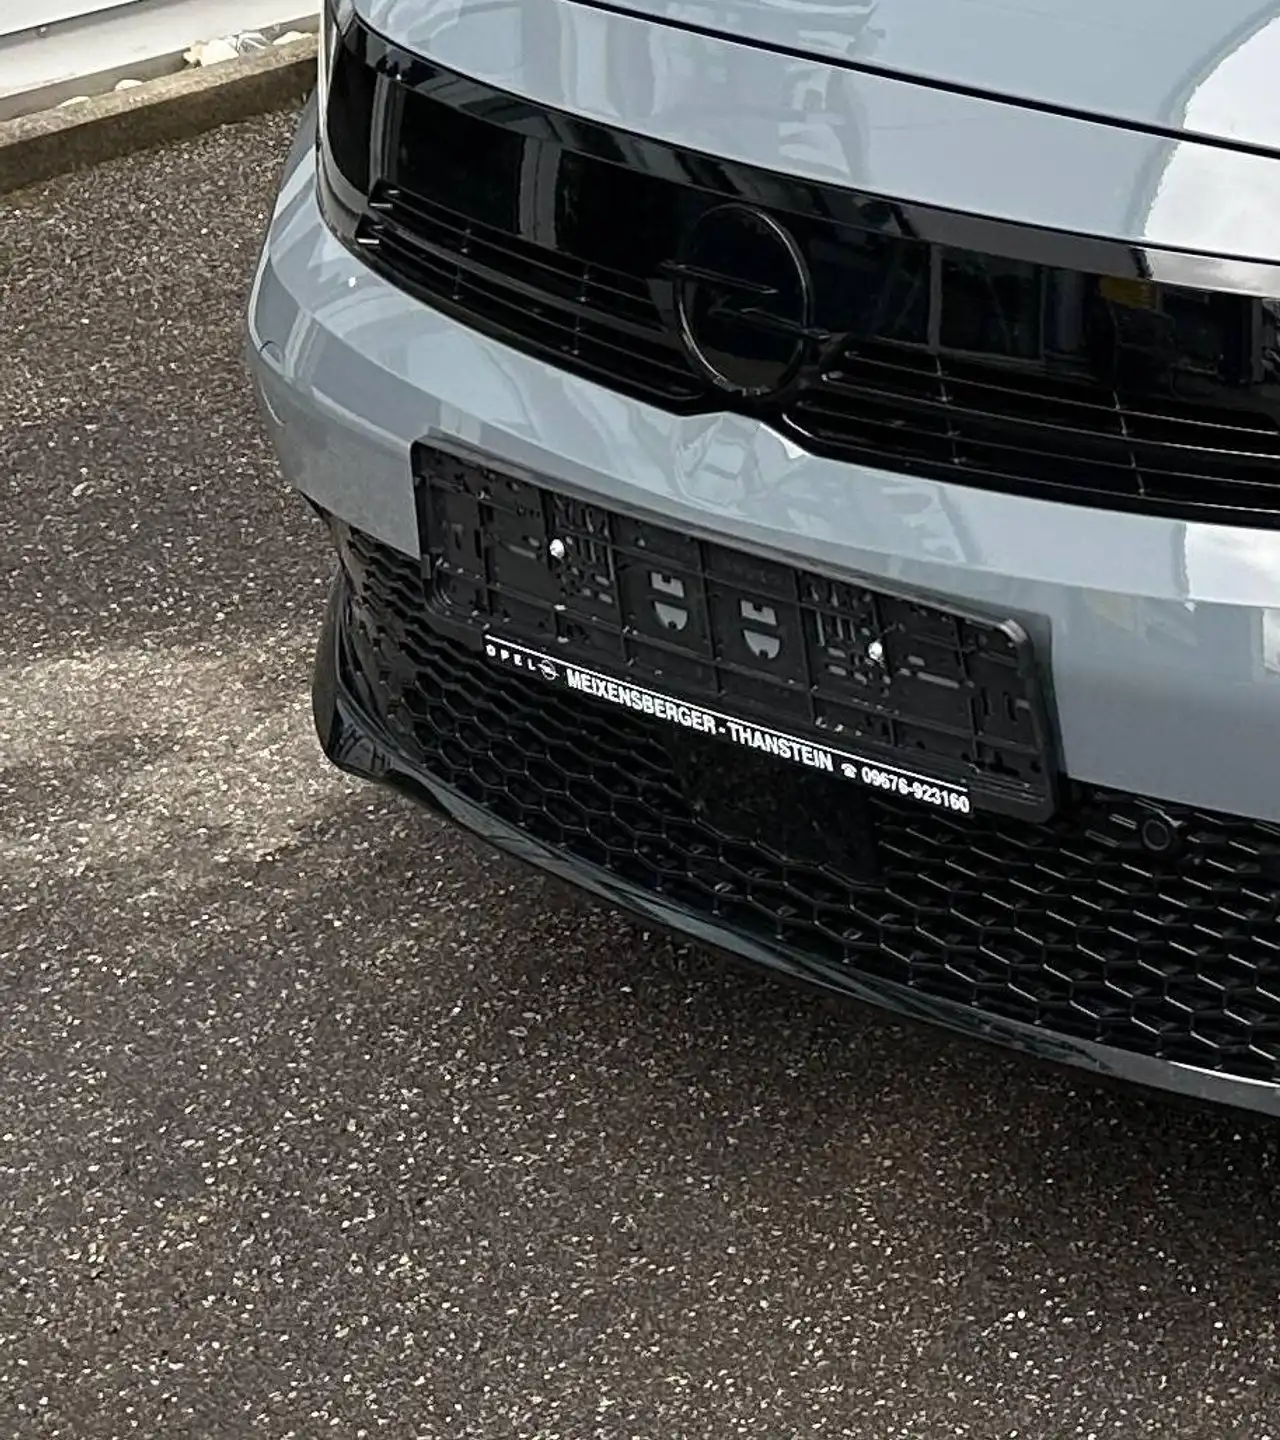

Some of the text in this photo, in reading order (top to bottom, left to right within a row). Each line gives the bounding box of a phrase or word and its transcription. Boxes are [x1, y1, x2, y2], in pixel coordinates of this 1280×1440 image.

[486, 643, 537, 672] OPEL
[726, 721, 834, 773] THANSTEIN
[860, 766, 971, 814] 09676-923160
